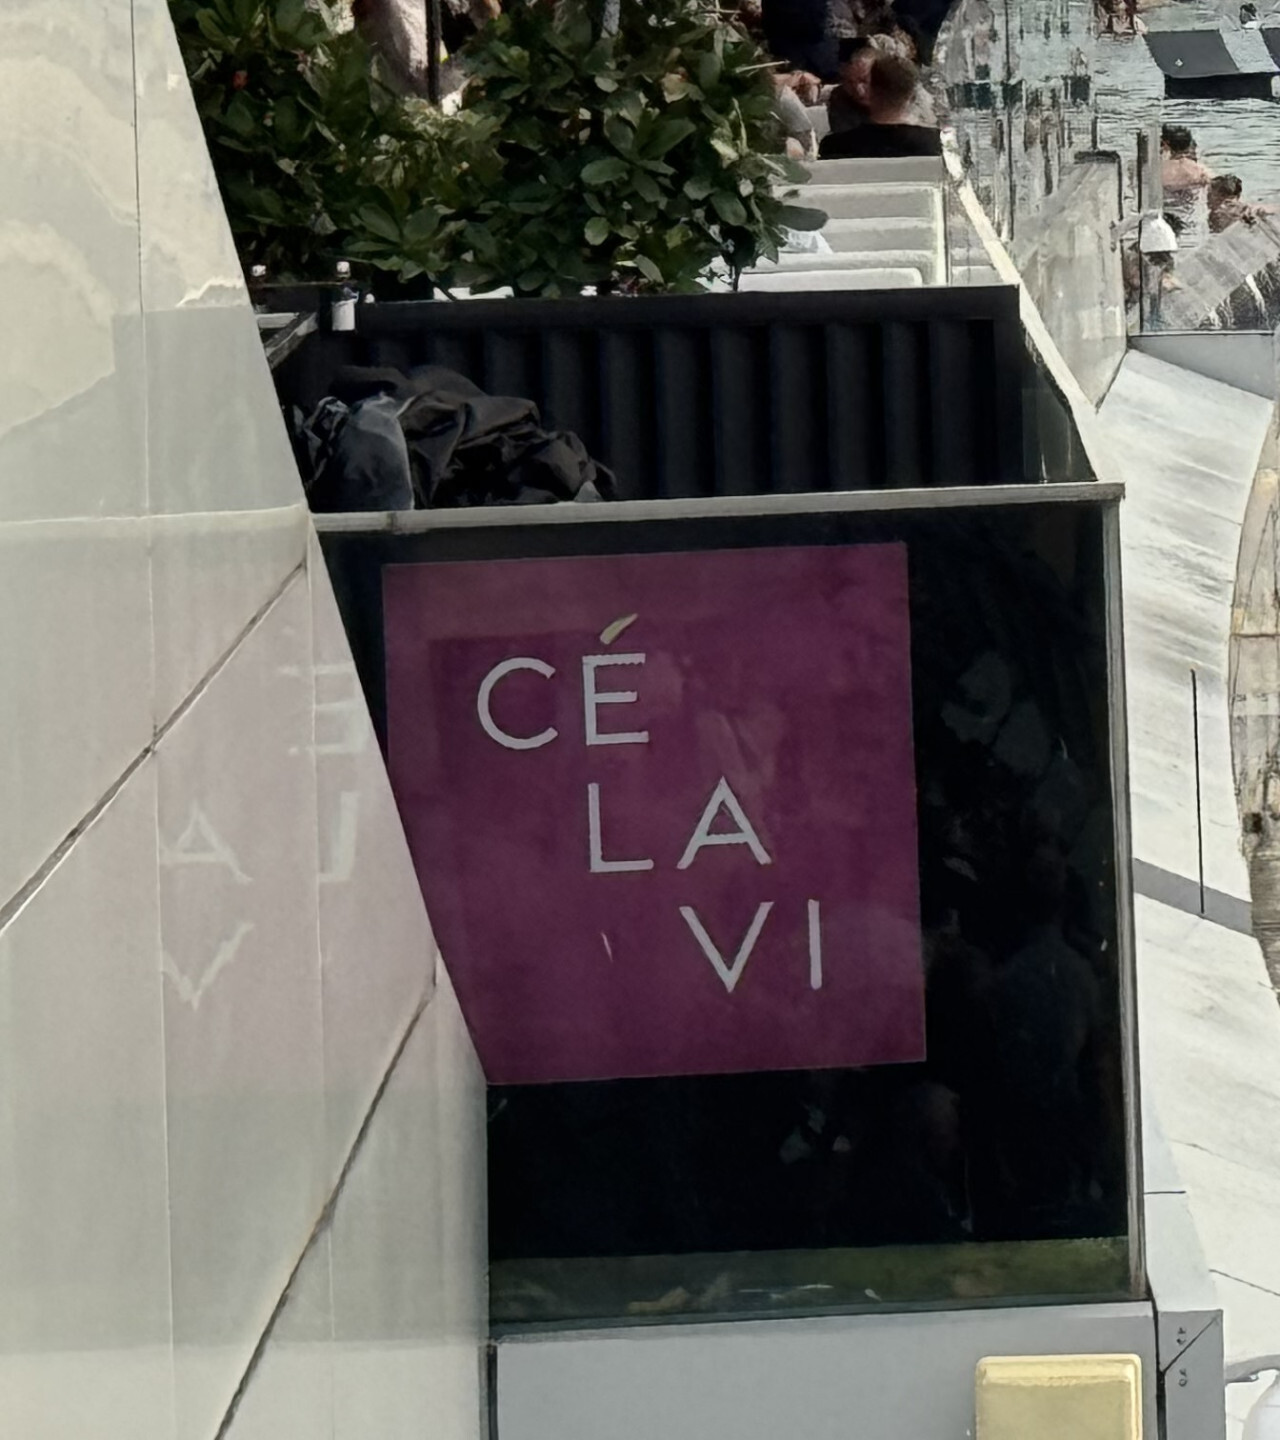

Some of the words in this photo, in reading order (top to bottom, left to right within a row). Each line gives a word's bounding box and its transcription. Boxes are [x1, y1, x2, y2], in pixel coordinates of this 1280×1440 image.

[477, 613, 650, 750] CÉ
[587, 777, 772, 873] LA
[679, 899, 823, 993] VI
